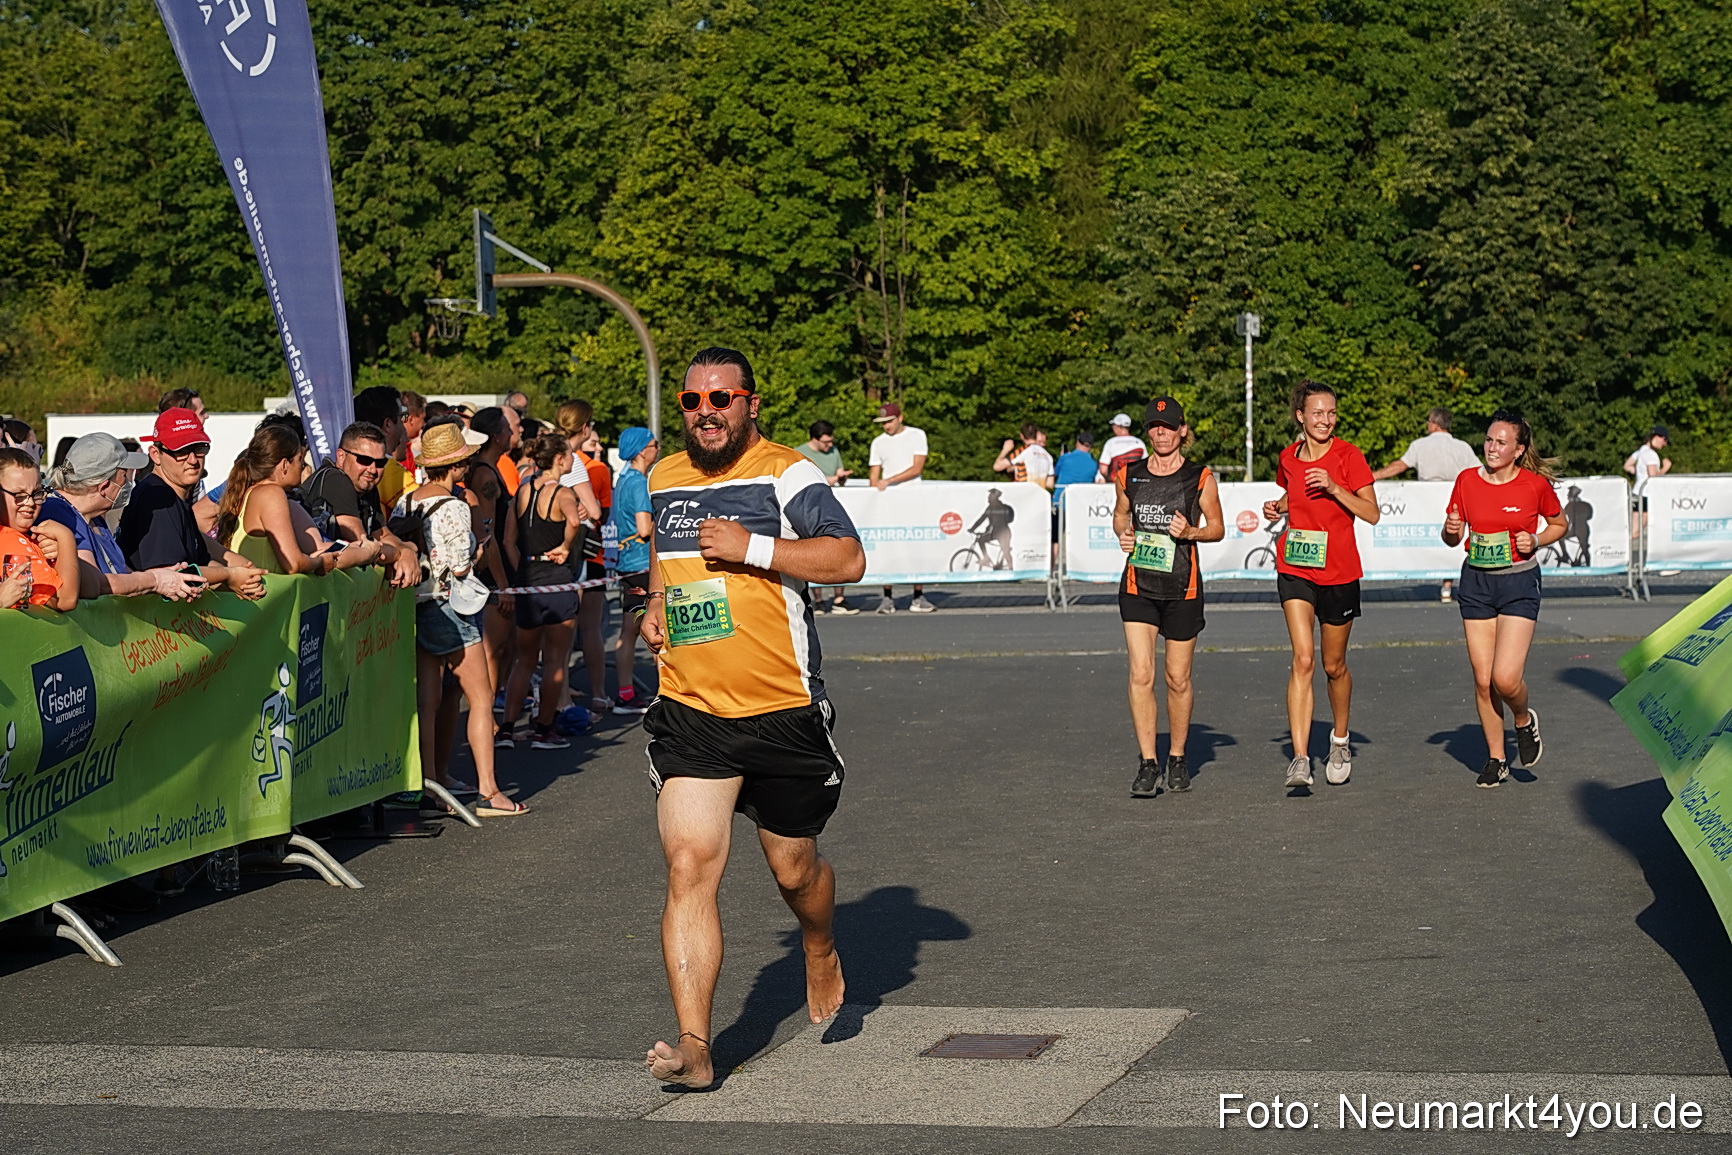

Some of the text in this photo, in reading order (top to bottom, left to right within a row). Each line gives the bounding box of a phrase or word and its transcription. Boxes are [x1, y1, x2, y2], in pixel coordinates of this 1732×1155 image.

[1135, 503, 1166, 514] HECK
[1380, 503, 1406, 515] OW
[1671, 498, 1707, 510] NOW
[1375, 525, 1438, 537] E-BIKES &
[1674, 520, 1723, 531] E-BIKES
[860, 527, 941, 541] FAHRRÄDER
[1138, 544, 1166, 559] 1743
[1290, 541, 1318, 555] 1703
[1476, 544, 1504, 556] 1712
[672, 600, 716, 626] 1820
[716, 602, 729, 630] 2022
[691, 622, 721, 632] Christian
[120, 609, 227, 674] Gesunde Firmen
[300, 636, 320, 658] Fischer
[48, 684, 88, 715] Fischer
[55, 704, 86, 725] AUTOMOBILE
[4, 720, 133, 840] firmenlauf
[86, 797, 226, 868] www.firmenlauf-oberpfalz.de
[11, 818, 58, 866] neumarkt
